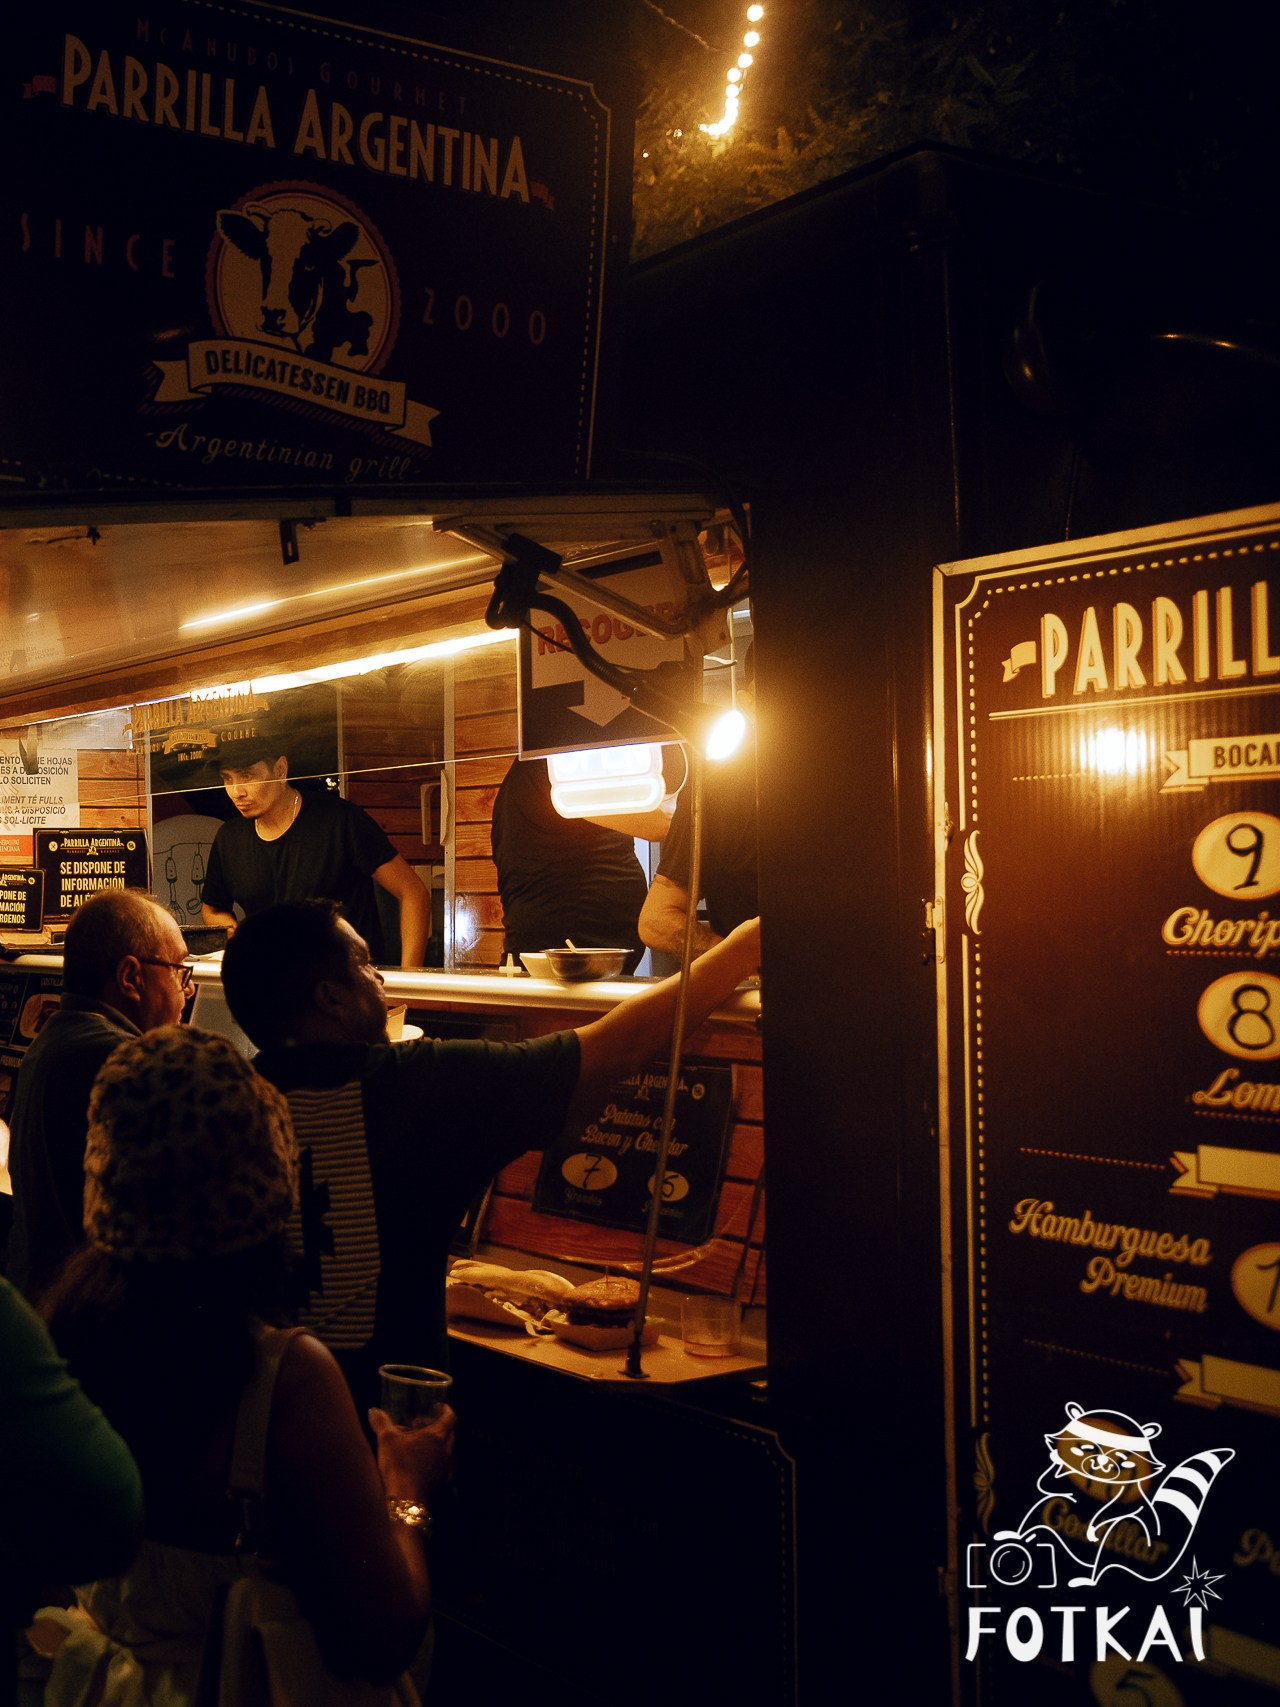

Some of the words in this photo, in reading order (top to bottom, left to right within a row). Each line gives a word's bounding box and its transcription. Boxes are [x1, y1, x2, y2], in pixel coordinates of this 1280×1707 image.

[61, 33, 278, 150] PARRILLA
[293, 87, 532, 204] ARGENTINA
[21, 212, 176, 280] SINCE
[422, 286, 548, 347] 2000
[206, 347, 351, 405] DELICATESSEN
[353, 382, 391, 414] BBQ
[1040, 580, 1280, 699] PARRILL
[12, 766, 19, 774] A
[20, 764, 69, 775] DOSICIÓN
[47, 757, 73, 766] HOJAS
[11, 777, 51, 785] SOLICITEN
[21, 804, 66, 815] DISPOSICIÓ
[28, 794, 38, 804] TÉ
[38, 796, 64, 804] FULLS
[63, 838, 89, 848] PARRILLA
[90, 837, 121, 848] ARGENTINA
[1226, 822, 1263, 890] 9
[1, 873, 25, 881] ARGENTINA
[60, 862, 72, 875] SE
[74, 861, 114, 875] DISPONE
[115, 861, 125, 874] DE
[61, 876, 125, 892] INFORMACIÓN
[17, 891, 26, 901] DE
[60, 894, 72, 908] DE
[1227, 984, 1275, 1050] 8
[634, 1130, 689, 1157] Chedar
[583, 1153, 602, 1189] 7
[1008, 1197, 1214, 1269] Hamburguesa
[1078, 1254, 1210, 1314] Premium
